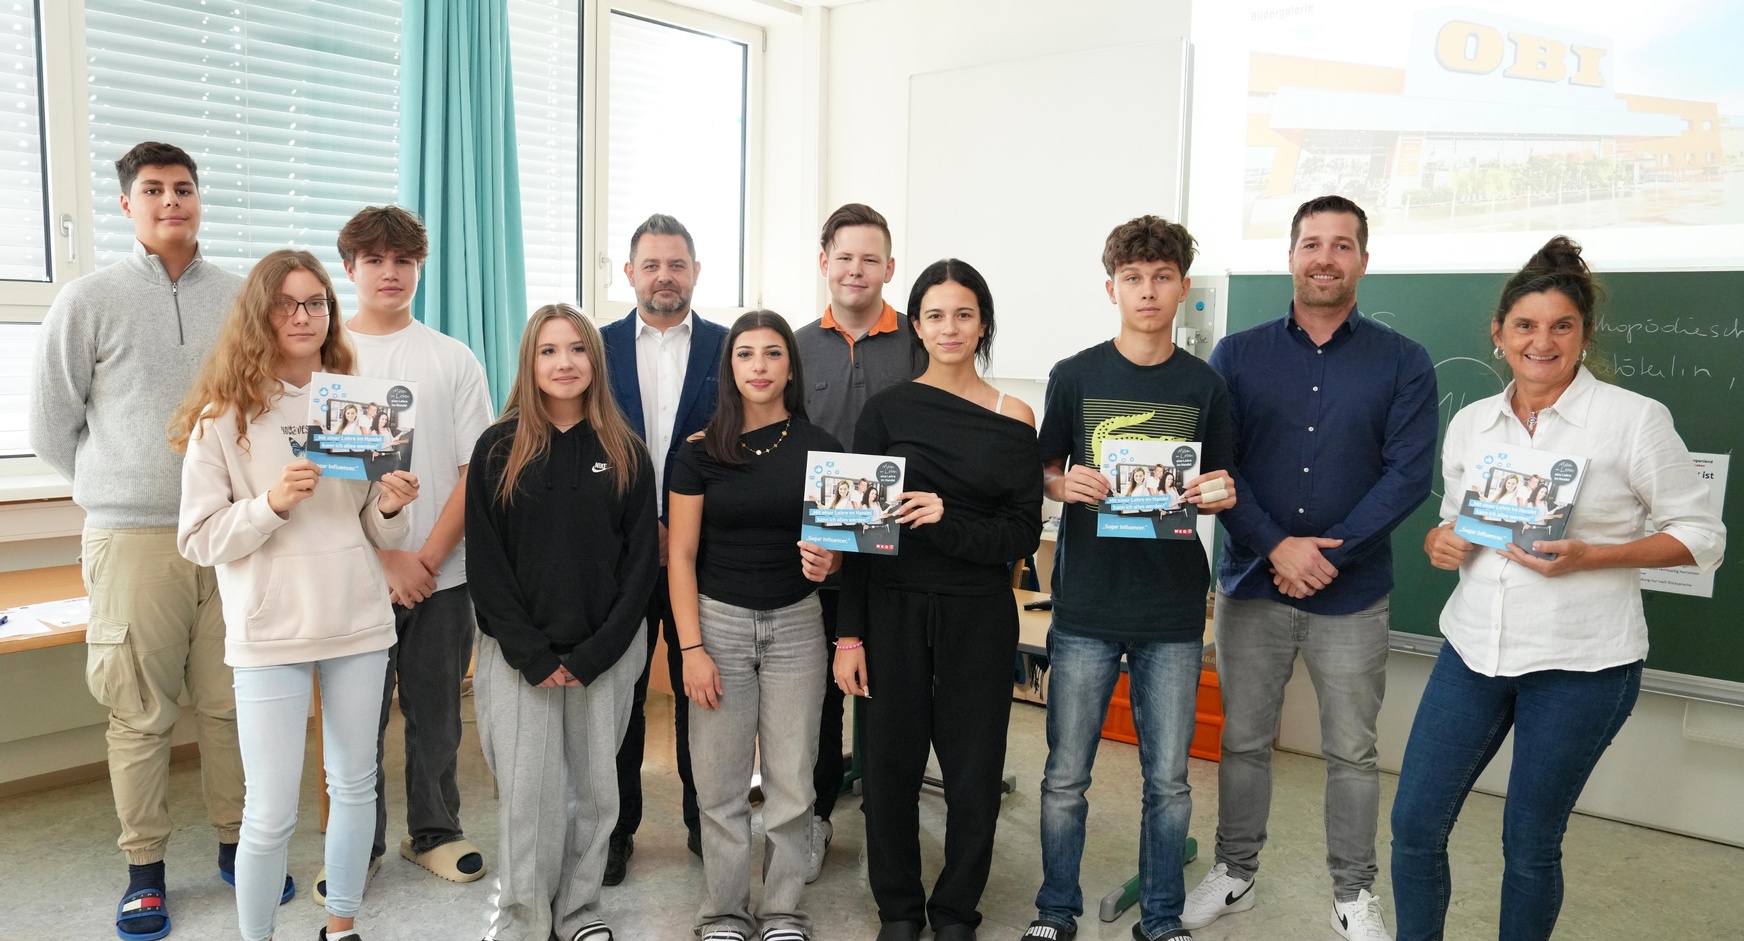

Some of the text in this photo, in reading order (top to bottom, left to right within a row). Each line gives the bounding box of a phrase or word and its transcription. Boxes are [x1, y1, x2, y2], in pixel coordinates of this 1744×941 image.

[1251, 3, 1314, 21] Bildergalerie
[1435, 20, 1607, 88] OBI
[1702, 471, 1714, 479] ist
